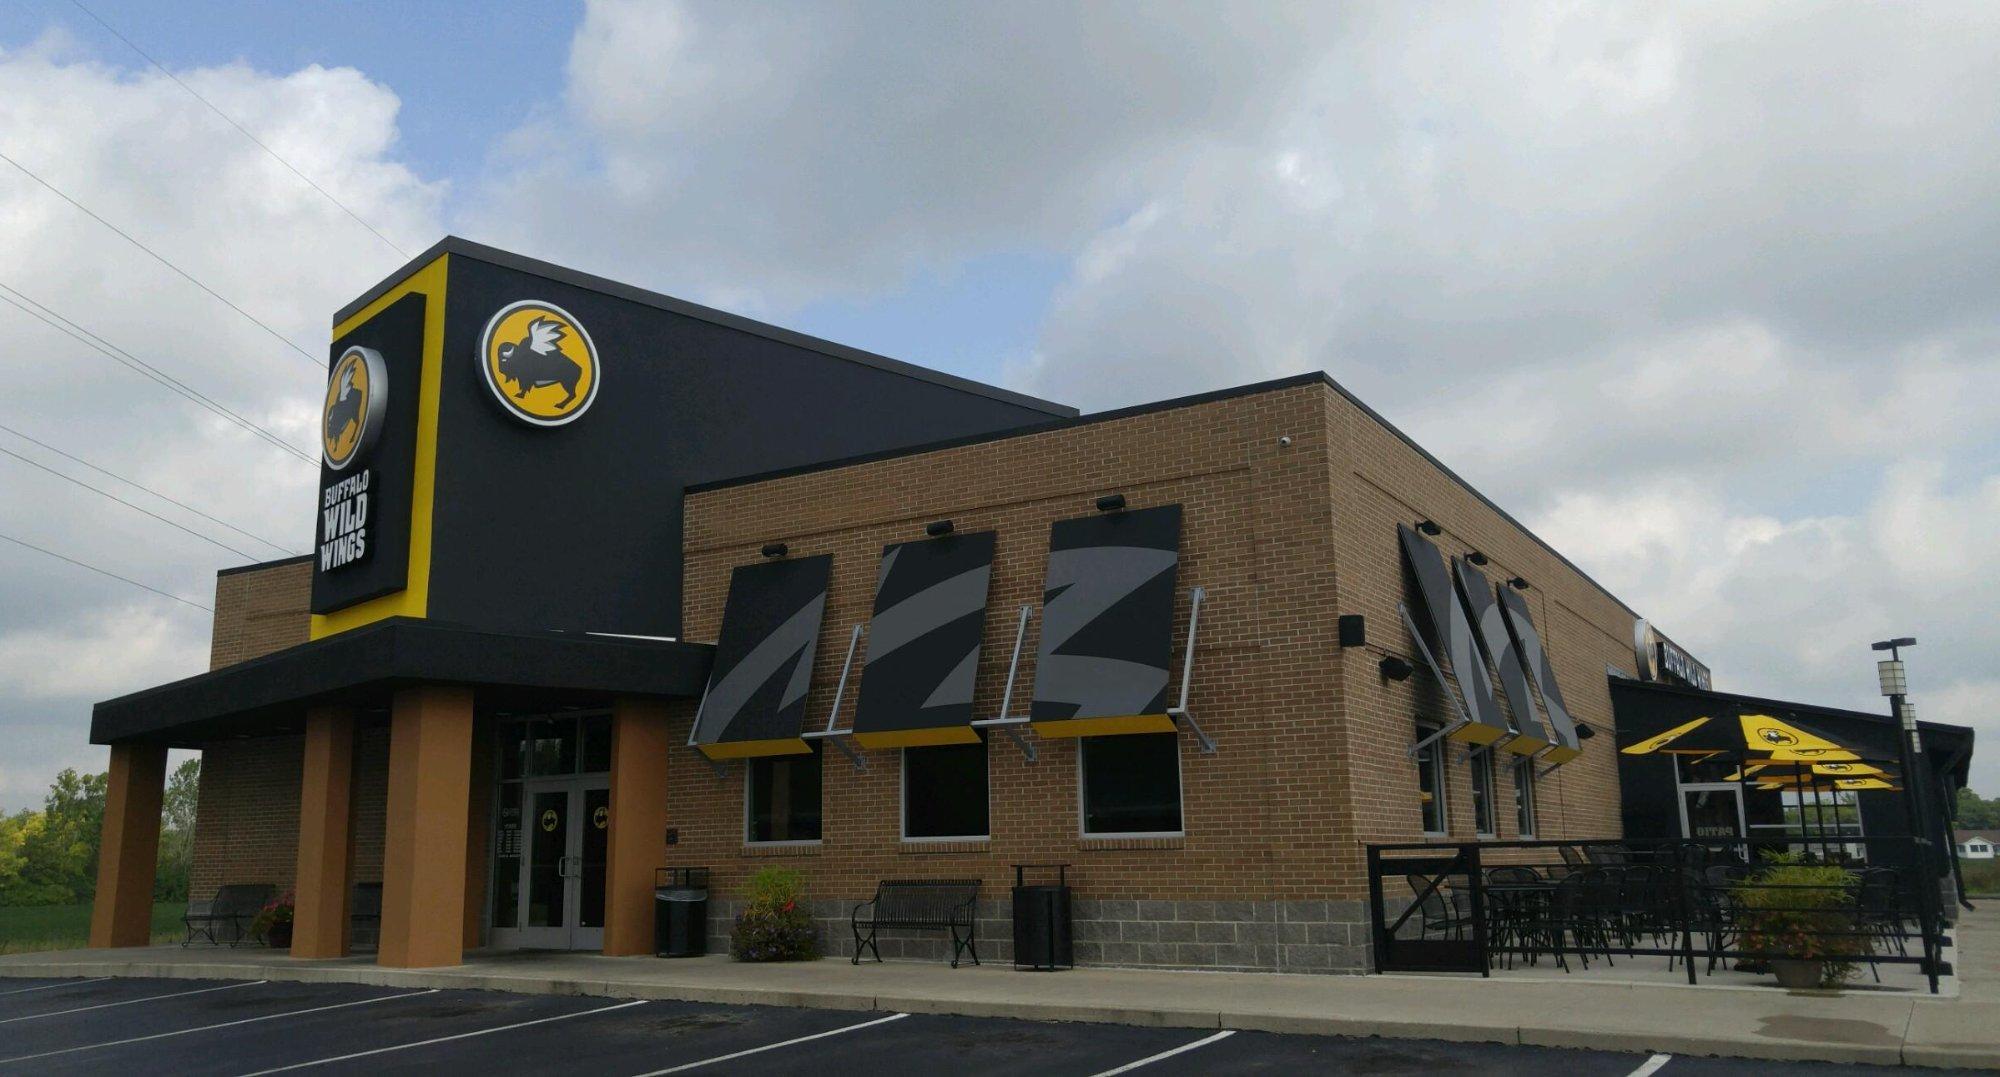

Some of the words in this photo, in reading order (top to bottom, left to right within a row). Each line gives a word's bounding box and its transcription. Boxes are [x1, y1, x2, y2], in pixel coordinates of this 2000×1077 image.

[325, 469, 369, 508] BUFFALO
[324, 493, 367, 542] WILD
[321, 528, 366, 572] WINGS
